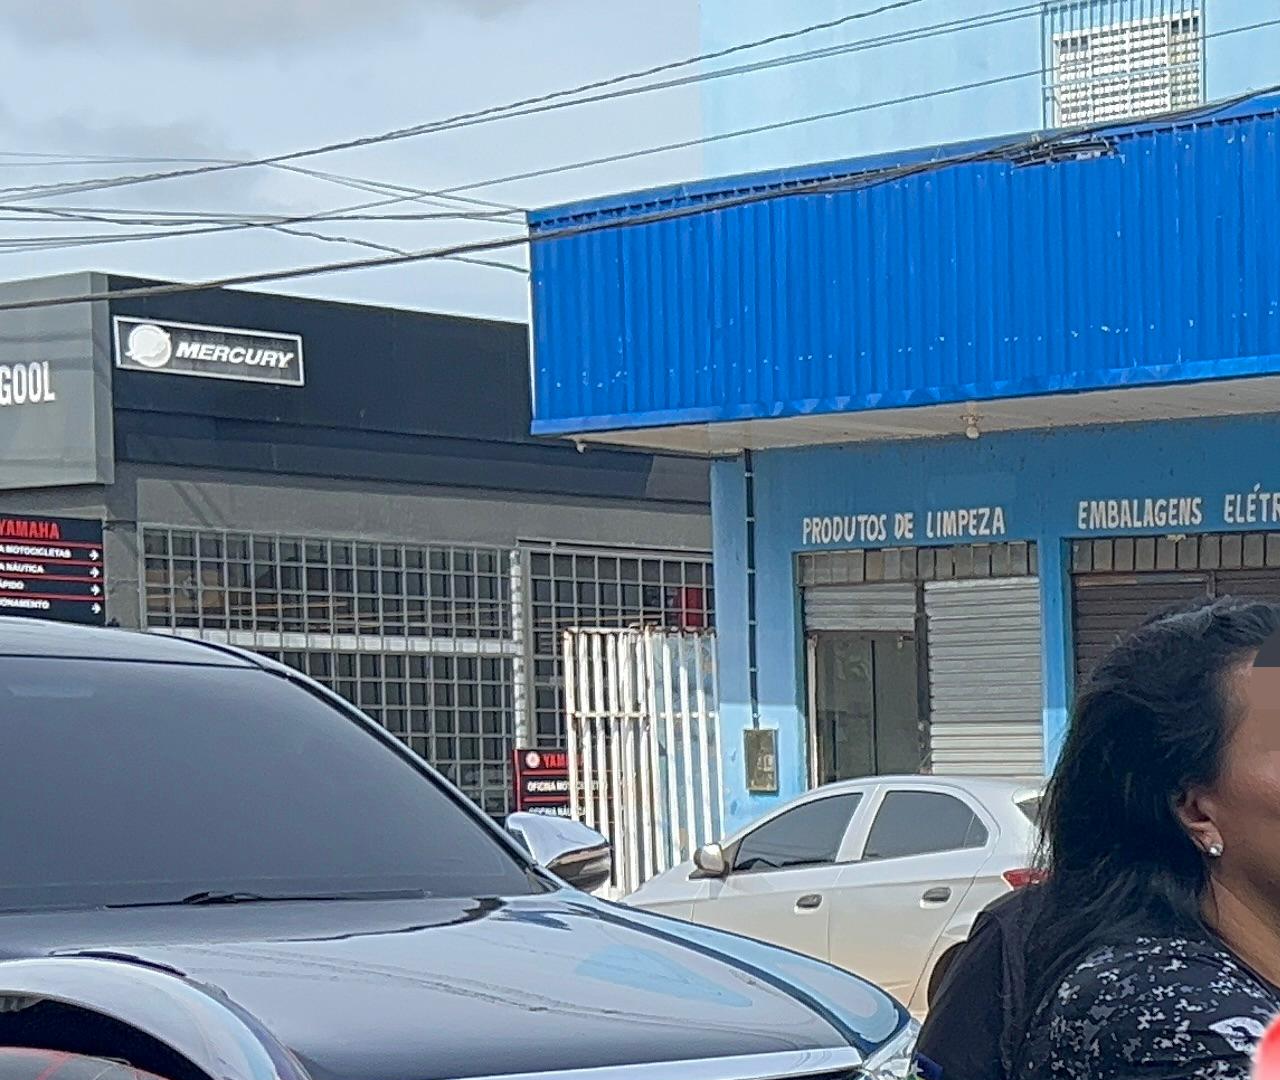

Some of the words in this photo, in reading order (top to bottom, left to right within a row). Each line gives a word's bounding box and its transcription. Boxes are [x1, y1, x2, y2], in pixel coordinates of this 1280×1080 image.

[175, 341, 294, 368] MERCURY
[803, 513, 886, 544] PRODUTOS
[894, 511, 914, 539] DE
[926, 507, 1005, 537] LIMPEZA
[1078, 497, 1203, 529] EMBALAGENS
